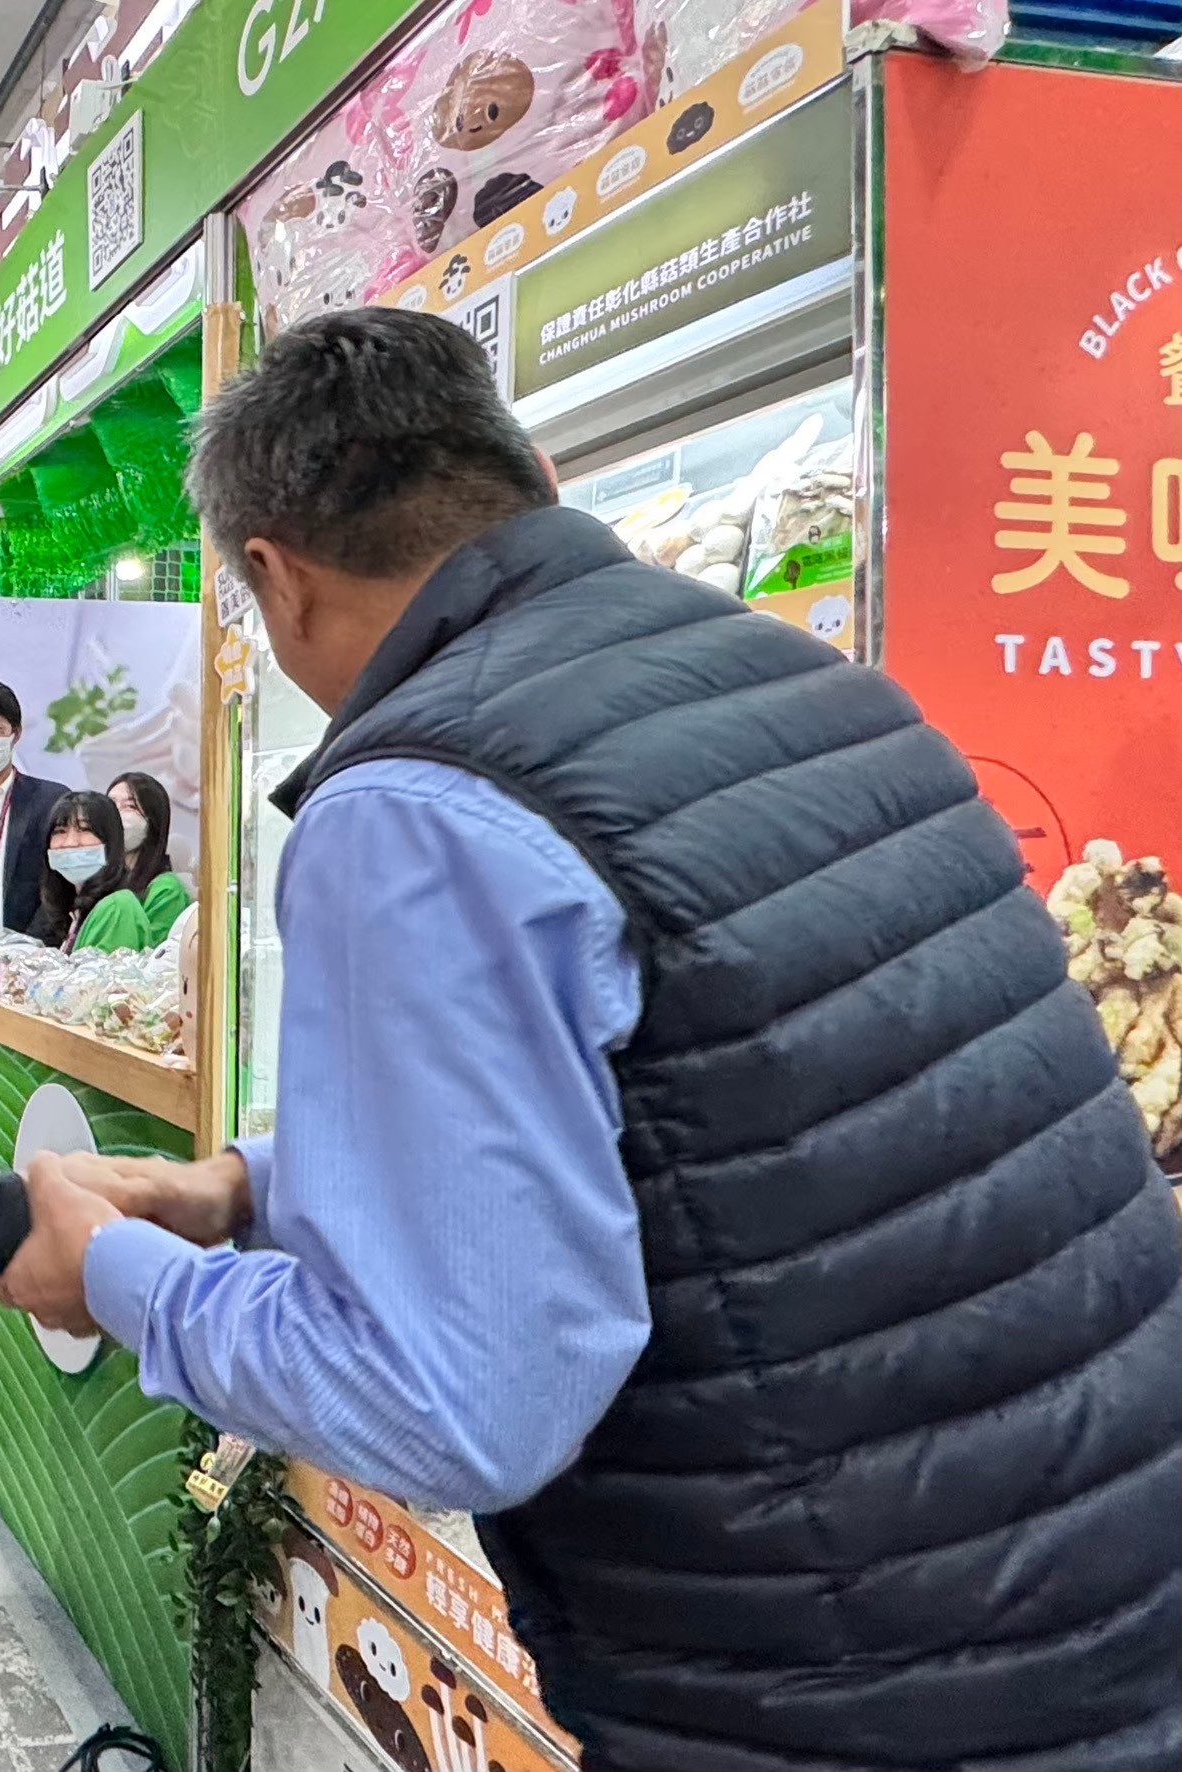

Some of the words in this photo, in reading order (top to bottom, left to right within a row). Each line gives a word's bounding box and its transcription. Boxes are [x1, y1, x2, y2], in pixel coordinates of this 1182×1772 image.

[539, 325, 607, 365] CHANGHUA
[610, 283, 692, 331] MUSHROOM
[697, 224, 812, 290] COOPERATIVE
[540, 191, 812, 346] 保證責任彰化縣菇類生產合作社
[1079, 257, 1173, 359] BLACK
